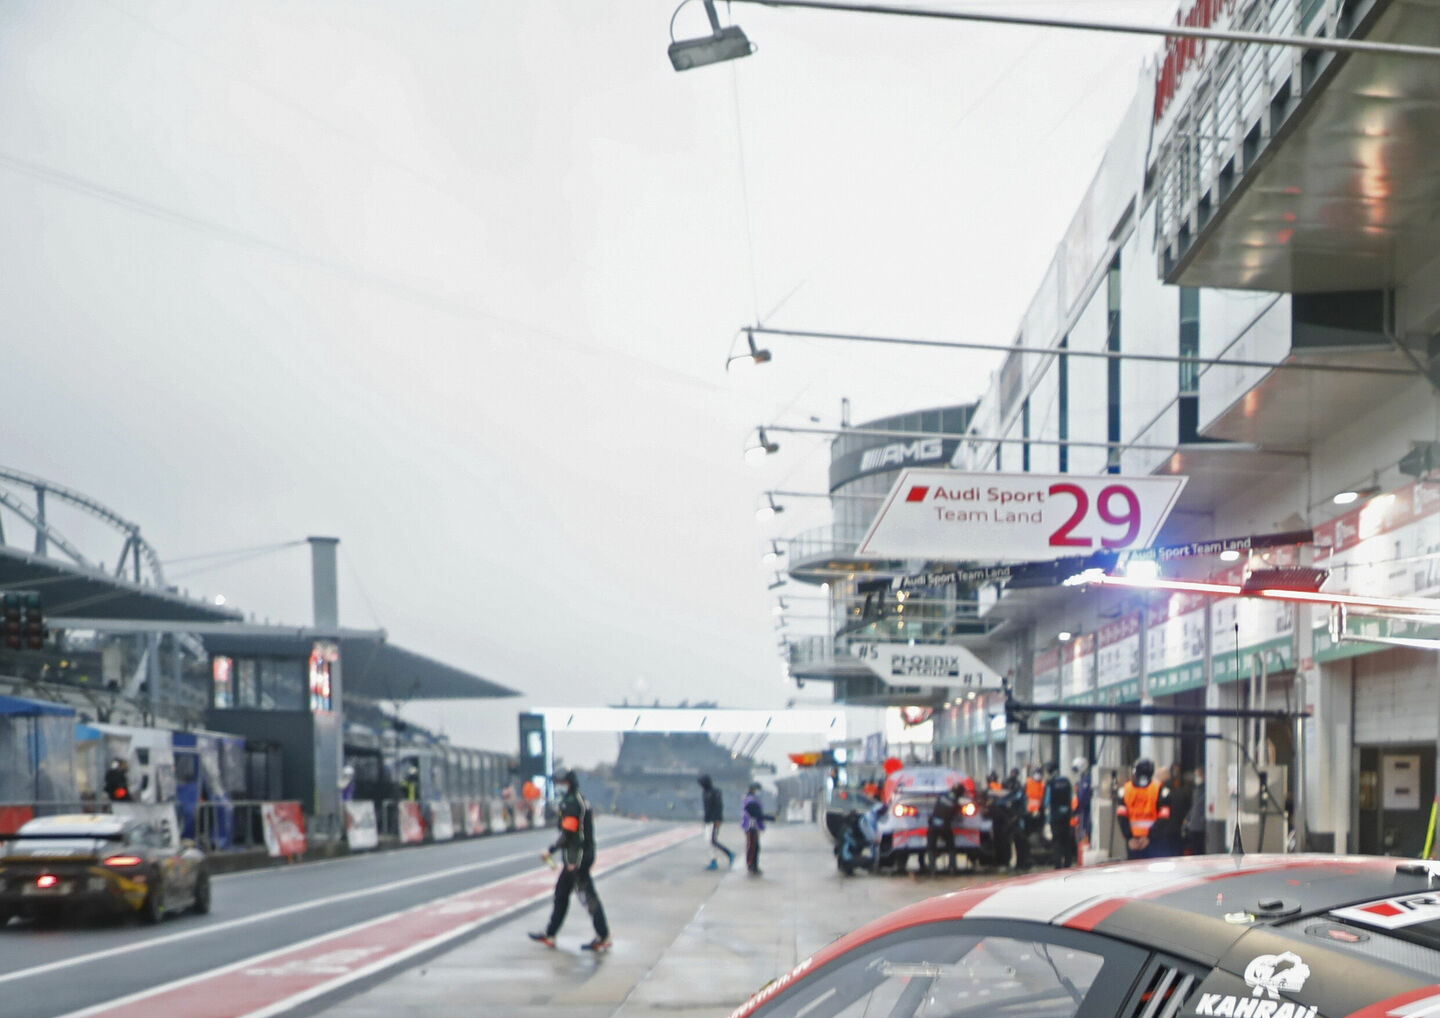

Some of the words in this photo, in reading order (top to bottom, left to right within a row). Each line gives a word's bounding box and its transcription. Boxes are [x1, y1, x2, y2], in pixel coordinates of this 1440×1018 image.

[881, 438, 943, 466] AMG
[933, 506, 990, 523] Team
[994, 506, 1043, 524] Land
[933, 485, 981, 502] Audi
[986, 486, 1045, 506] Sport
[1048, 483, 1142, 549] 29
[1159, 544, 1189, 561] Sport
[1191, 541, 1221, 556] Team
[1222, 537, 1252, 552] Land
[903, 574, 926, 588] Audi
[928, 571, 955, 588] Sport
[957, 568, 984, 583] Team
[985, 565, 1012, 580] Land
